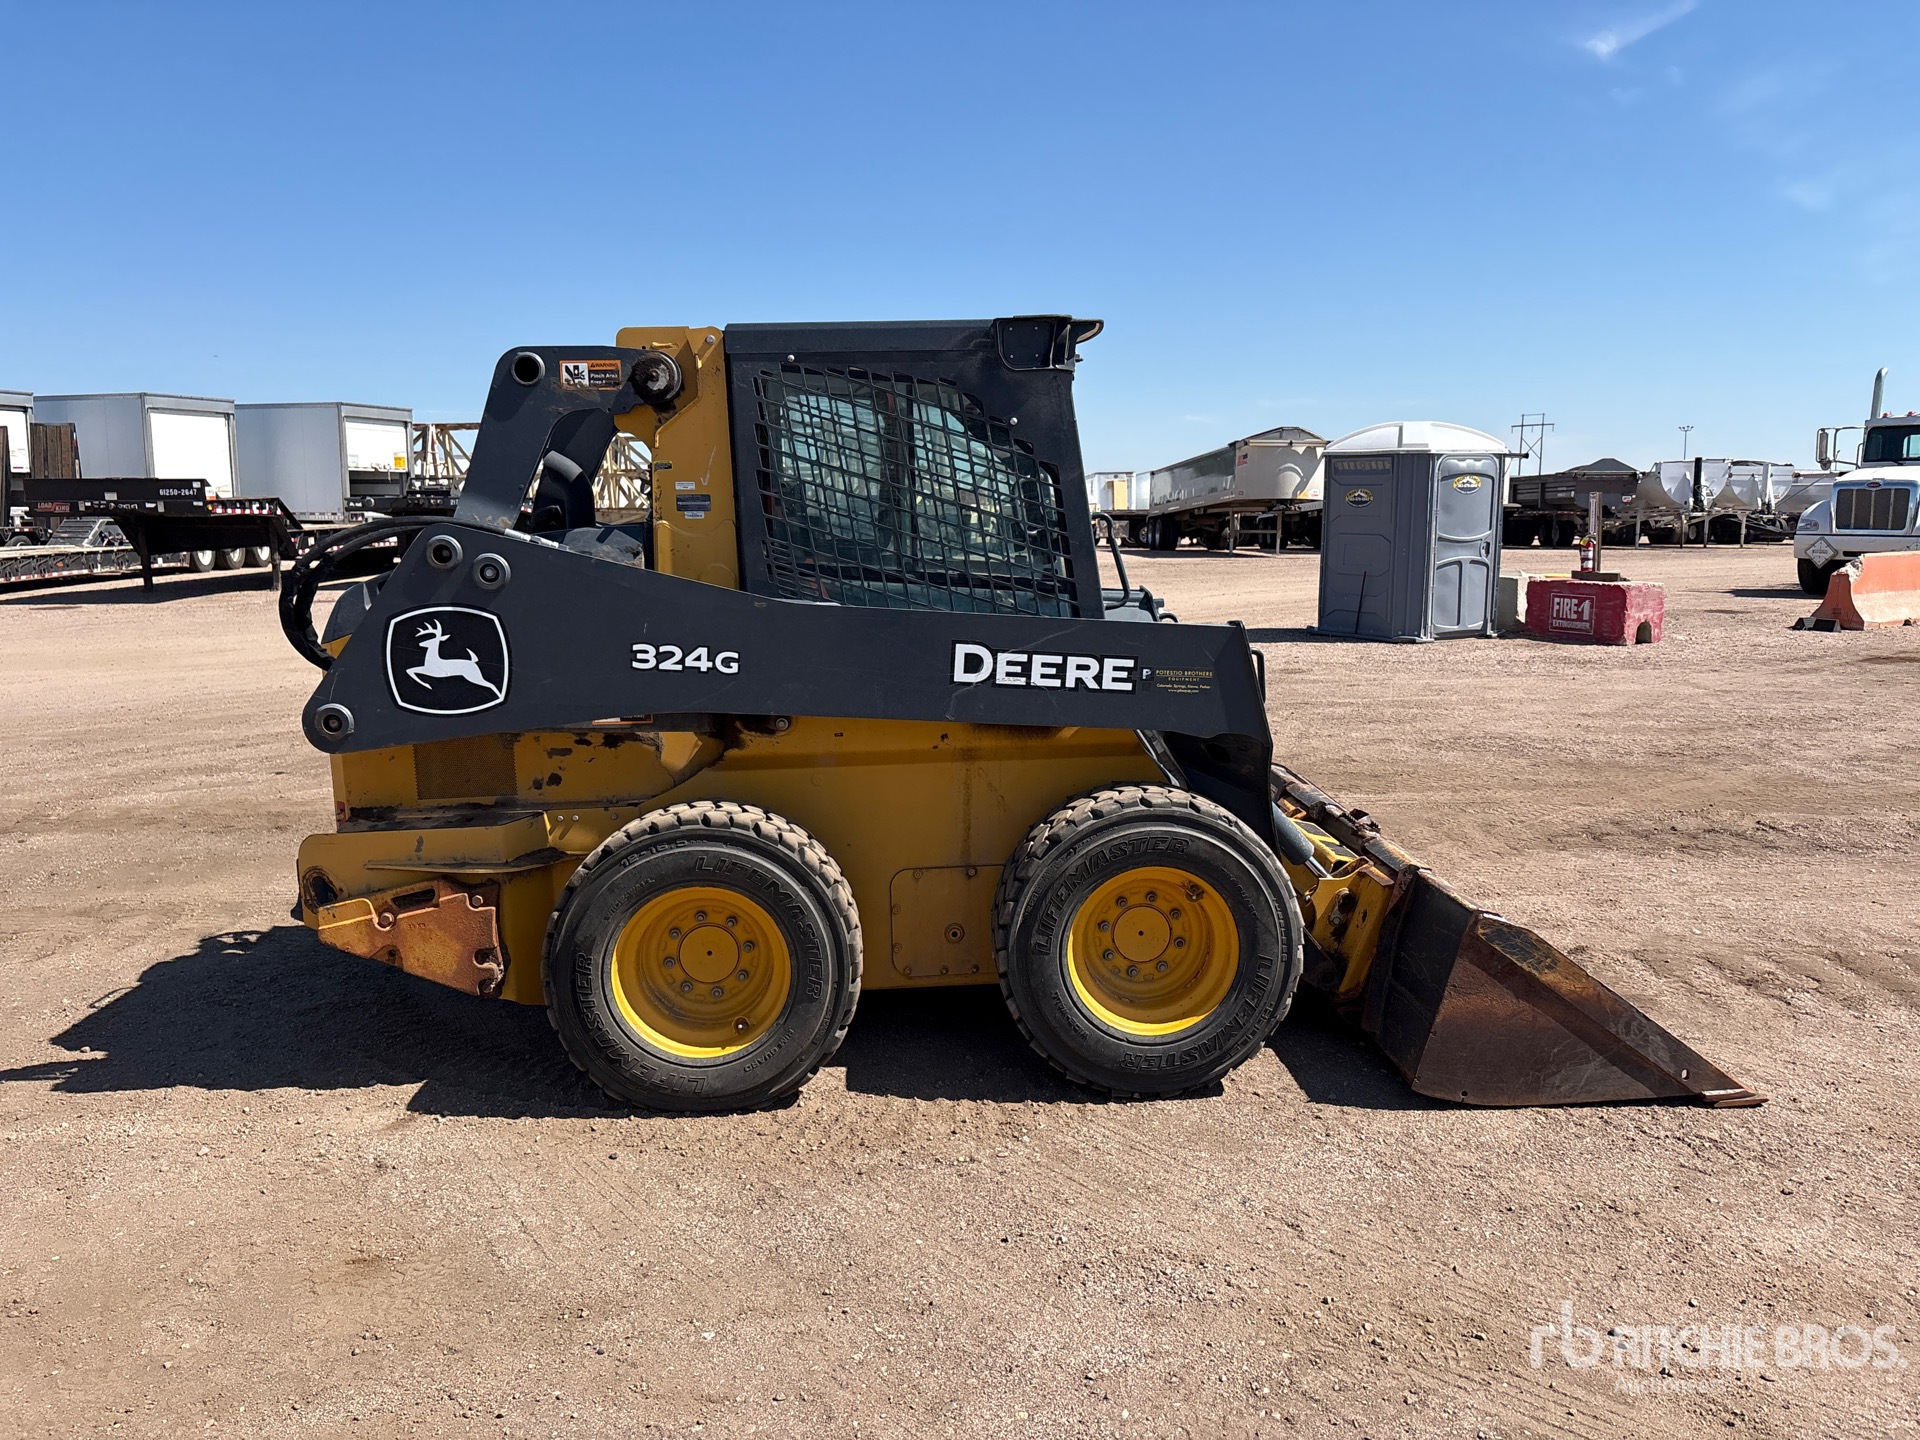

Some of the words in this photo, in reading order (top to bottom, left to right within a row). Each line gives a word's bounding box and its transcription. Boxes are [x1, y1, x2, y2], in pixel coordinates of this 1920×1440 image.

[1552, 619, 1590, 630] EXTINGUISHER
[1553, 597, 1578, 620] FIRE
[631, 643, 740, 674] 324G
[953, 643, 1135, 691] DEERE
[694, 855, 825, 999] LIFEMASTER
[1032, 835, 1192, 955] LIFEMASTER
[575, 951, 706, 1094] LIFEMASTER
[1119, 953, 1274, 1071] LIFEMASTER
